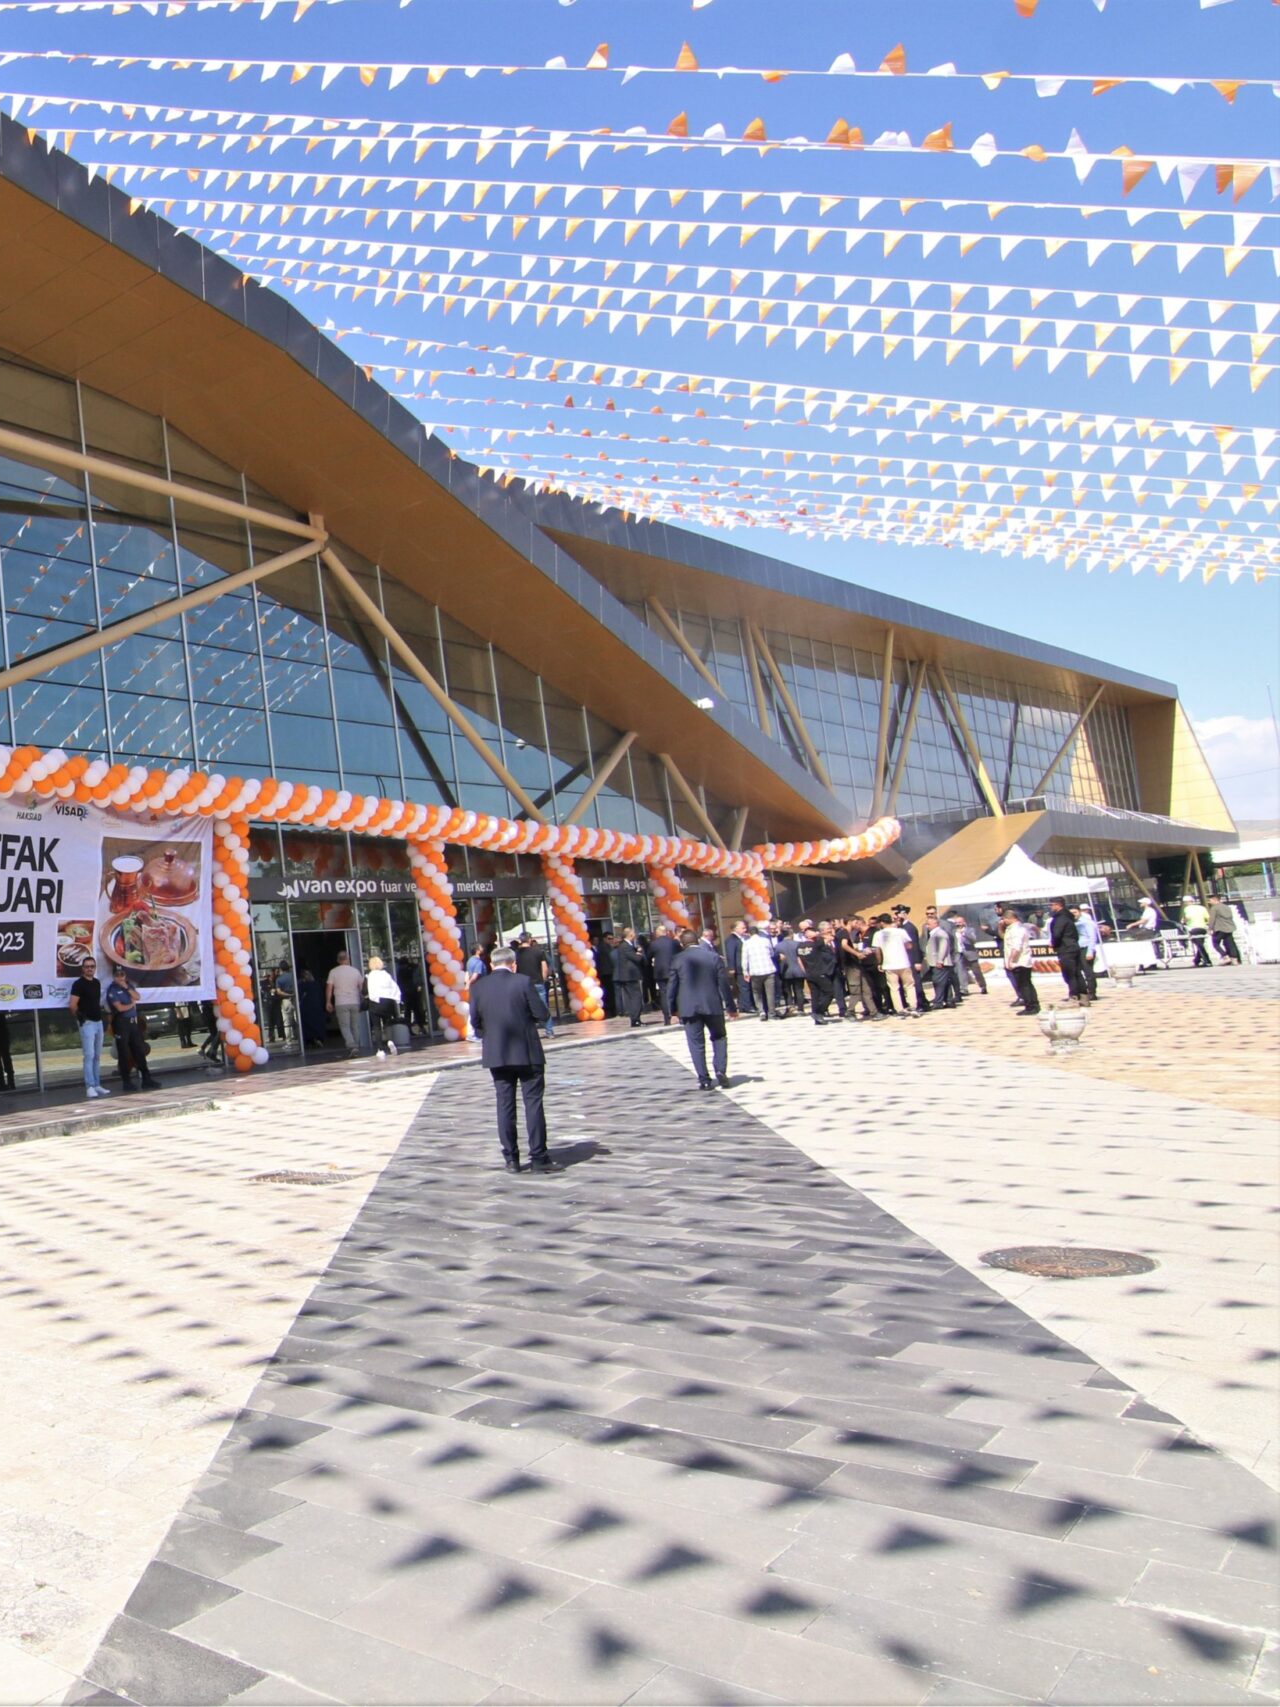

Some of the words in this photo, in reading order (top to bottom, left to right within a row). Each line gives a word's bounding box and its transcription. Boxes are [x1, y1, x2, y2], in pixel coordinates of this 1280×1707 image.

[299, 880, 332, 894] van
[335, 879, 377, 897] expo
[380, 881, 401, 893] fuar
[405, 882, 417, 893] ve
[456, 880, 494, 892] merkezi
[592, 878, 620, 893] Ajans
[623, 878, 647, 892] Asya
